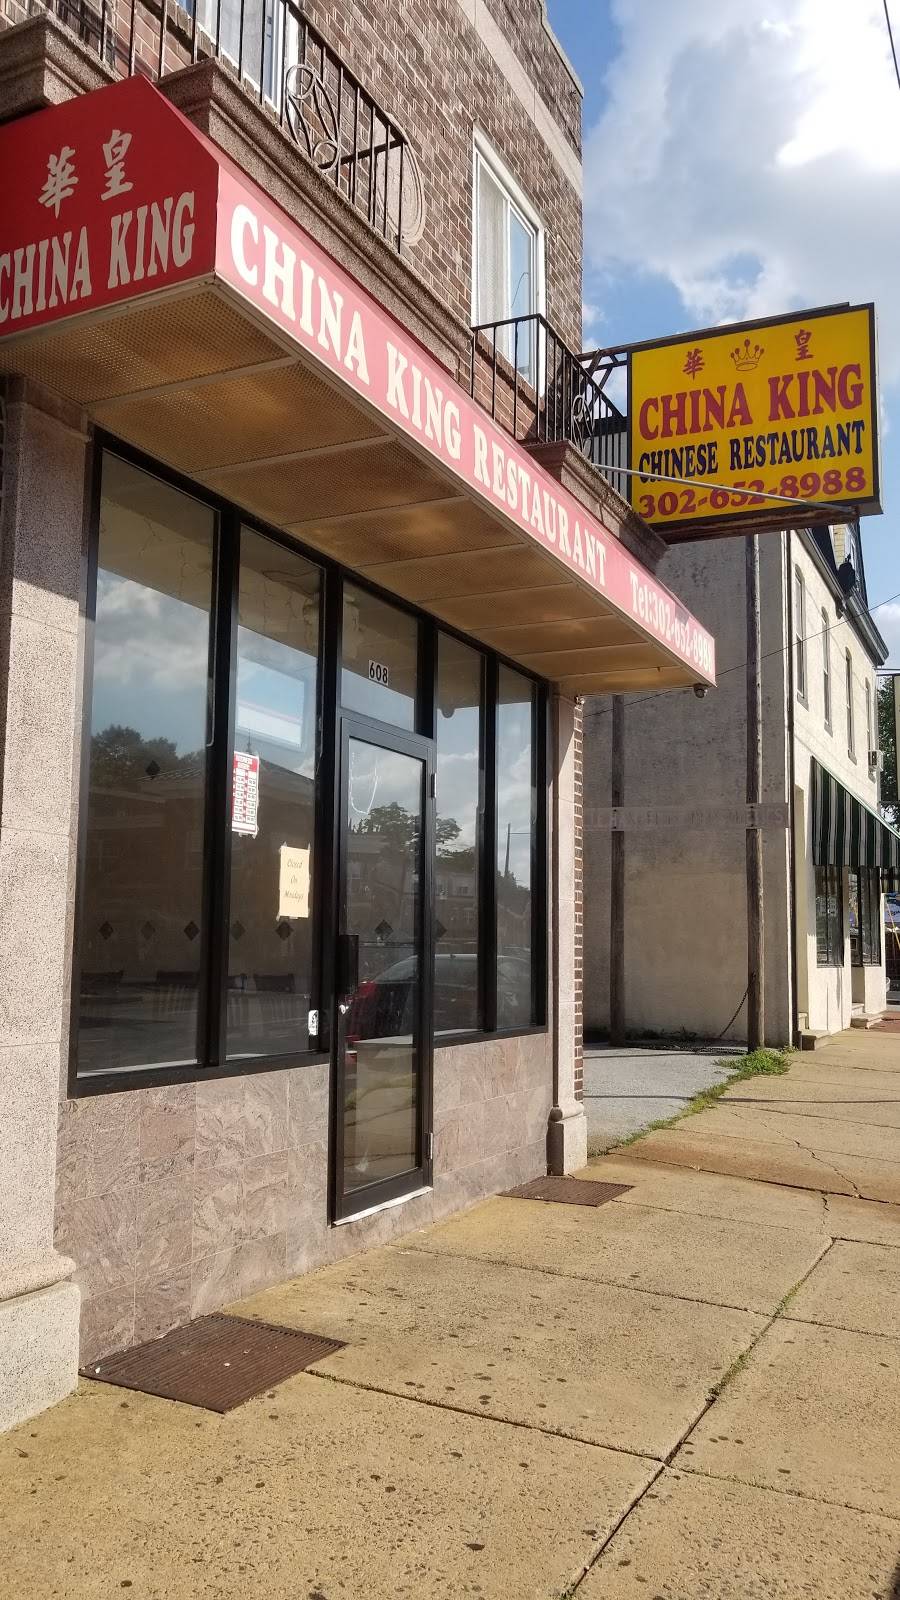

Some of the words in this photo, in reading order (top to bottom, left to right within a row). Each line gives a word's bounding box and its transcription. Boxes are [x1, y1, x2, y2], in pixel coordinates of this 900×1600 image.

[107, 191, 195, 289] KING
[682, 348, 706, 381] 華
[793, 328, 815, 362] 皇
[230, 203, 371, 386] CHINA
[386, 340, 462, 461] KING
[473, 423, 607, 588] RESTAURANT
[638, 382, 754, 441] CHINA
[767, 363, 865, 422] KING
[639, 442, 718, 484] CHINESE
[729, 419, 866, 472] RESTAURANT
[639, 467, 866, 518] 302-652-8988
[368, 664, 389, 684] 608
